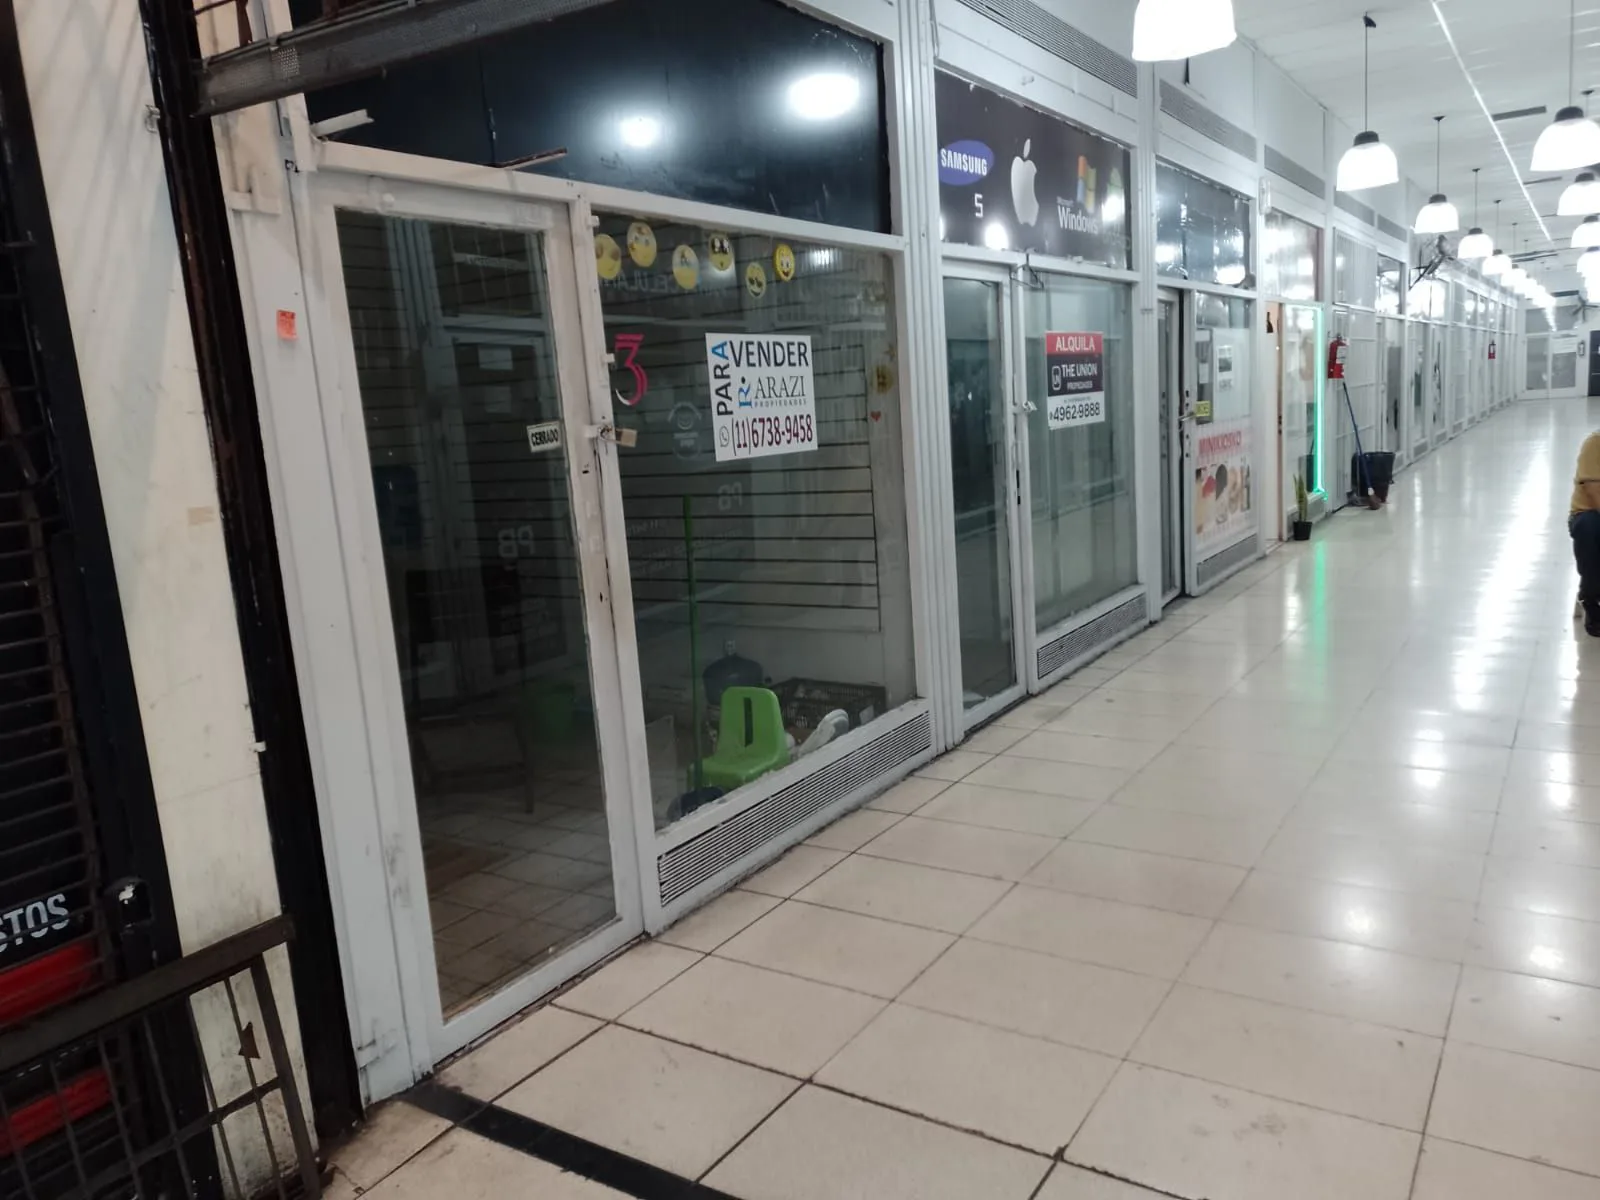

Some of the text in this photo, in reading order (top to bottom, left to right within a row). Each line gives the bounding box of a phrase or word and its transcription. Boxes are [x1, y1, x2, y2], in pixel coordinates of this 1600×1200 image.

[940, 147, 988, 177] SAMSUNG
[973, 192, 984, 218] 5
[1057, 204, 1099, 236] Windows
[729, 340, 809, 368] VENDER
[1055, 335, 1096, 352] ALQUILA
[615, 333, 648, 406] 3
[711, 341, 733, 416] PARA
[1061, 363, 1076, 378] THE
[1076, 362, 1098, 377] UNION
[754, 375, 806, 400] ARAZI
[531, 428, 559, 447] CERRADO
[731, 414, 813, 457] (11)6738-9458
